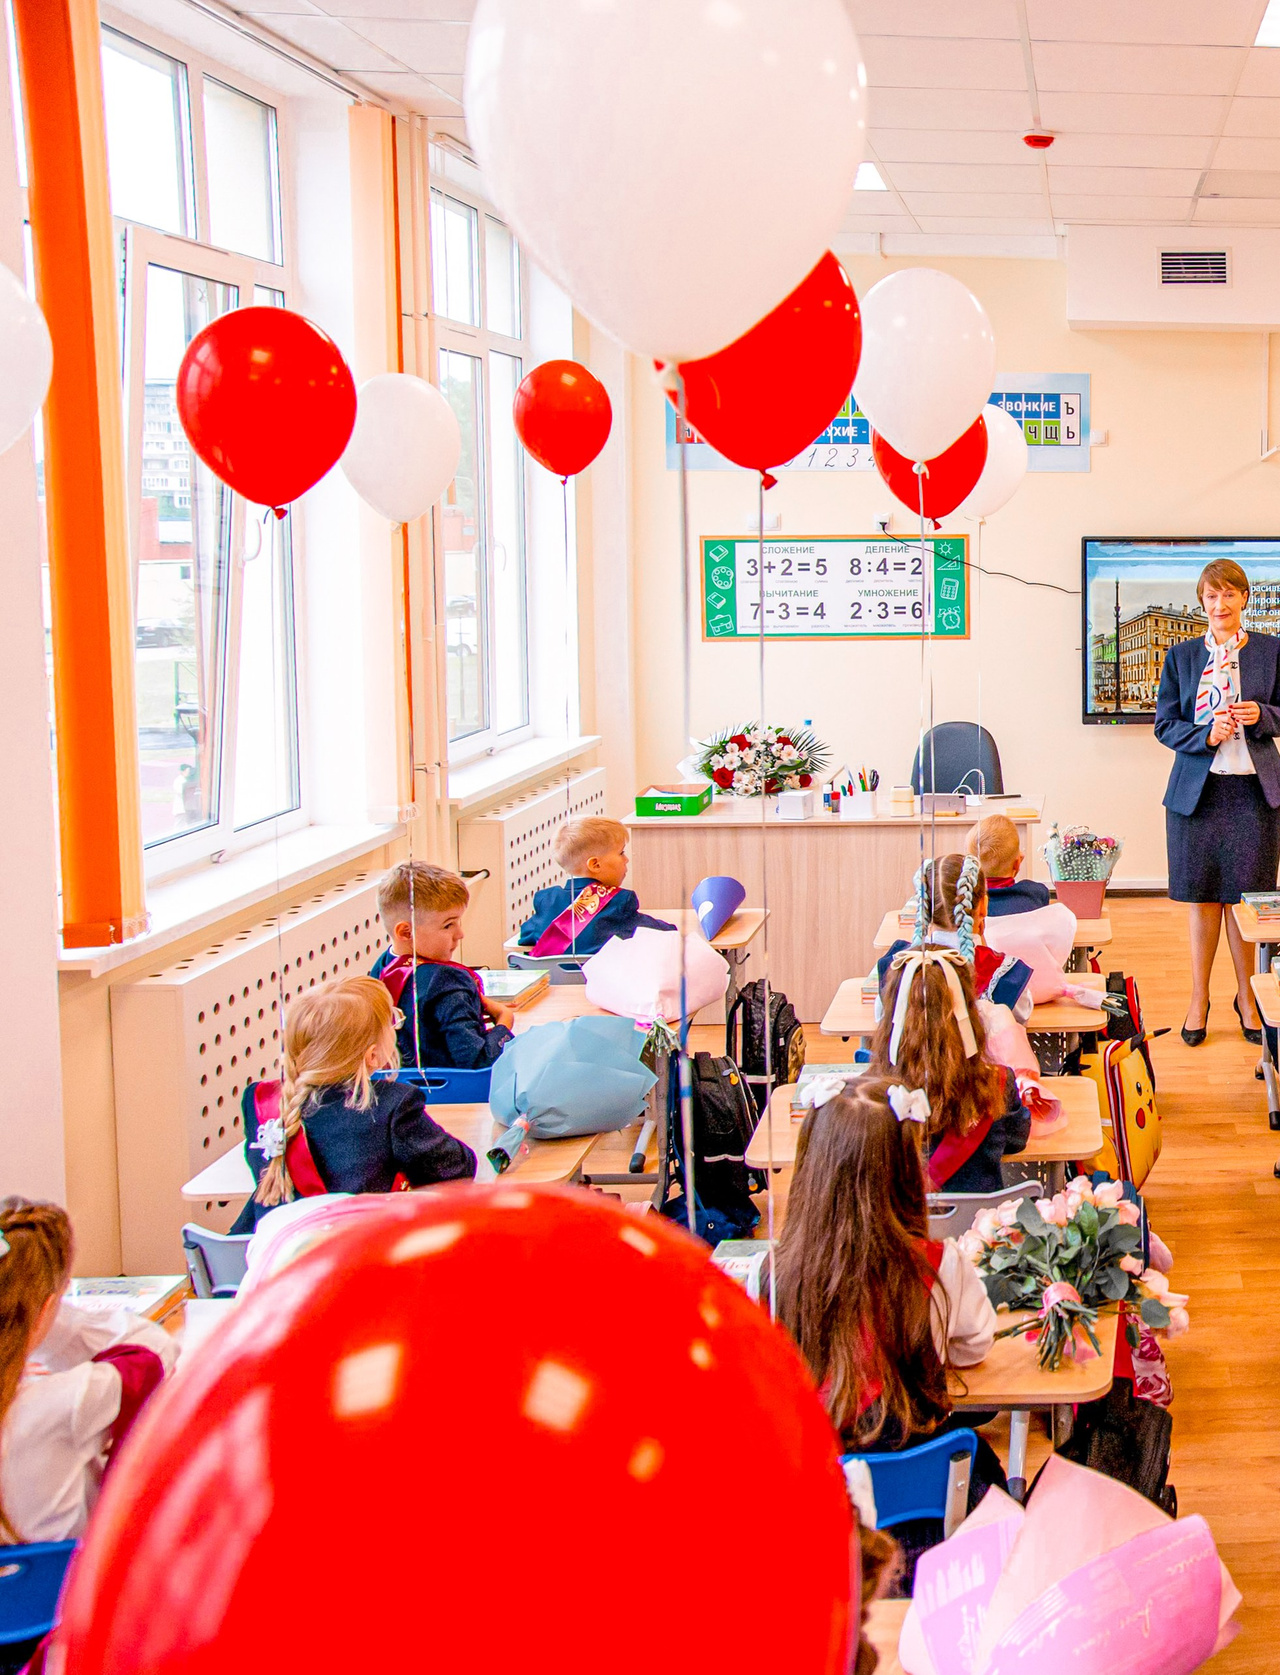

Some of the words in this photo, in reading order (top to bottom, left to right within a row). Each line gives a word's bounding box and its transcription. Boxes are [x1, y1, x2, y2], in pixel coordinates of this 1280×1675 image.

[998, 401, 1056, 412] ЗВОНКИЕ
[1065, 402, 1074, 415] Ъ
[822, 427, 858, 436] УХИЕ
[1029, 426, 1037, 439] Ч
[1045, 426, 1058, 441] Щ
[1067, 426, 1075, 439] Ь
[808, 448, 817, 467] 1
[825, 448, 838, 467] 2
[847, 448, 859, 467] 3
[865, 546, 910, 554] ДЕЛЕНИЕ
[858, 589, 918, 597] УМНОЖЕНИЕ
